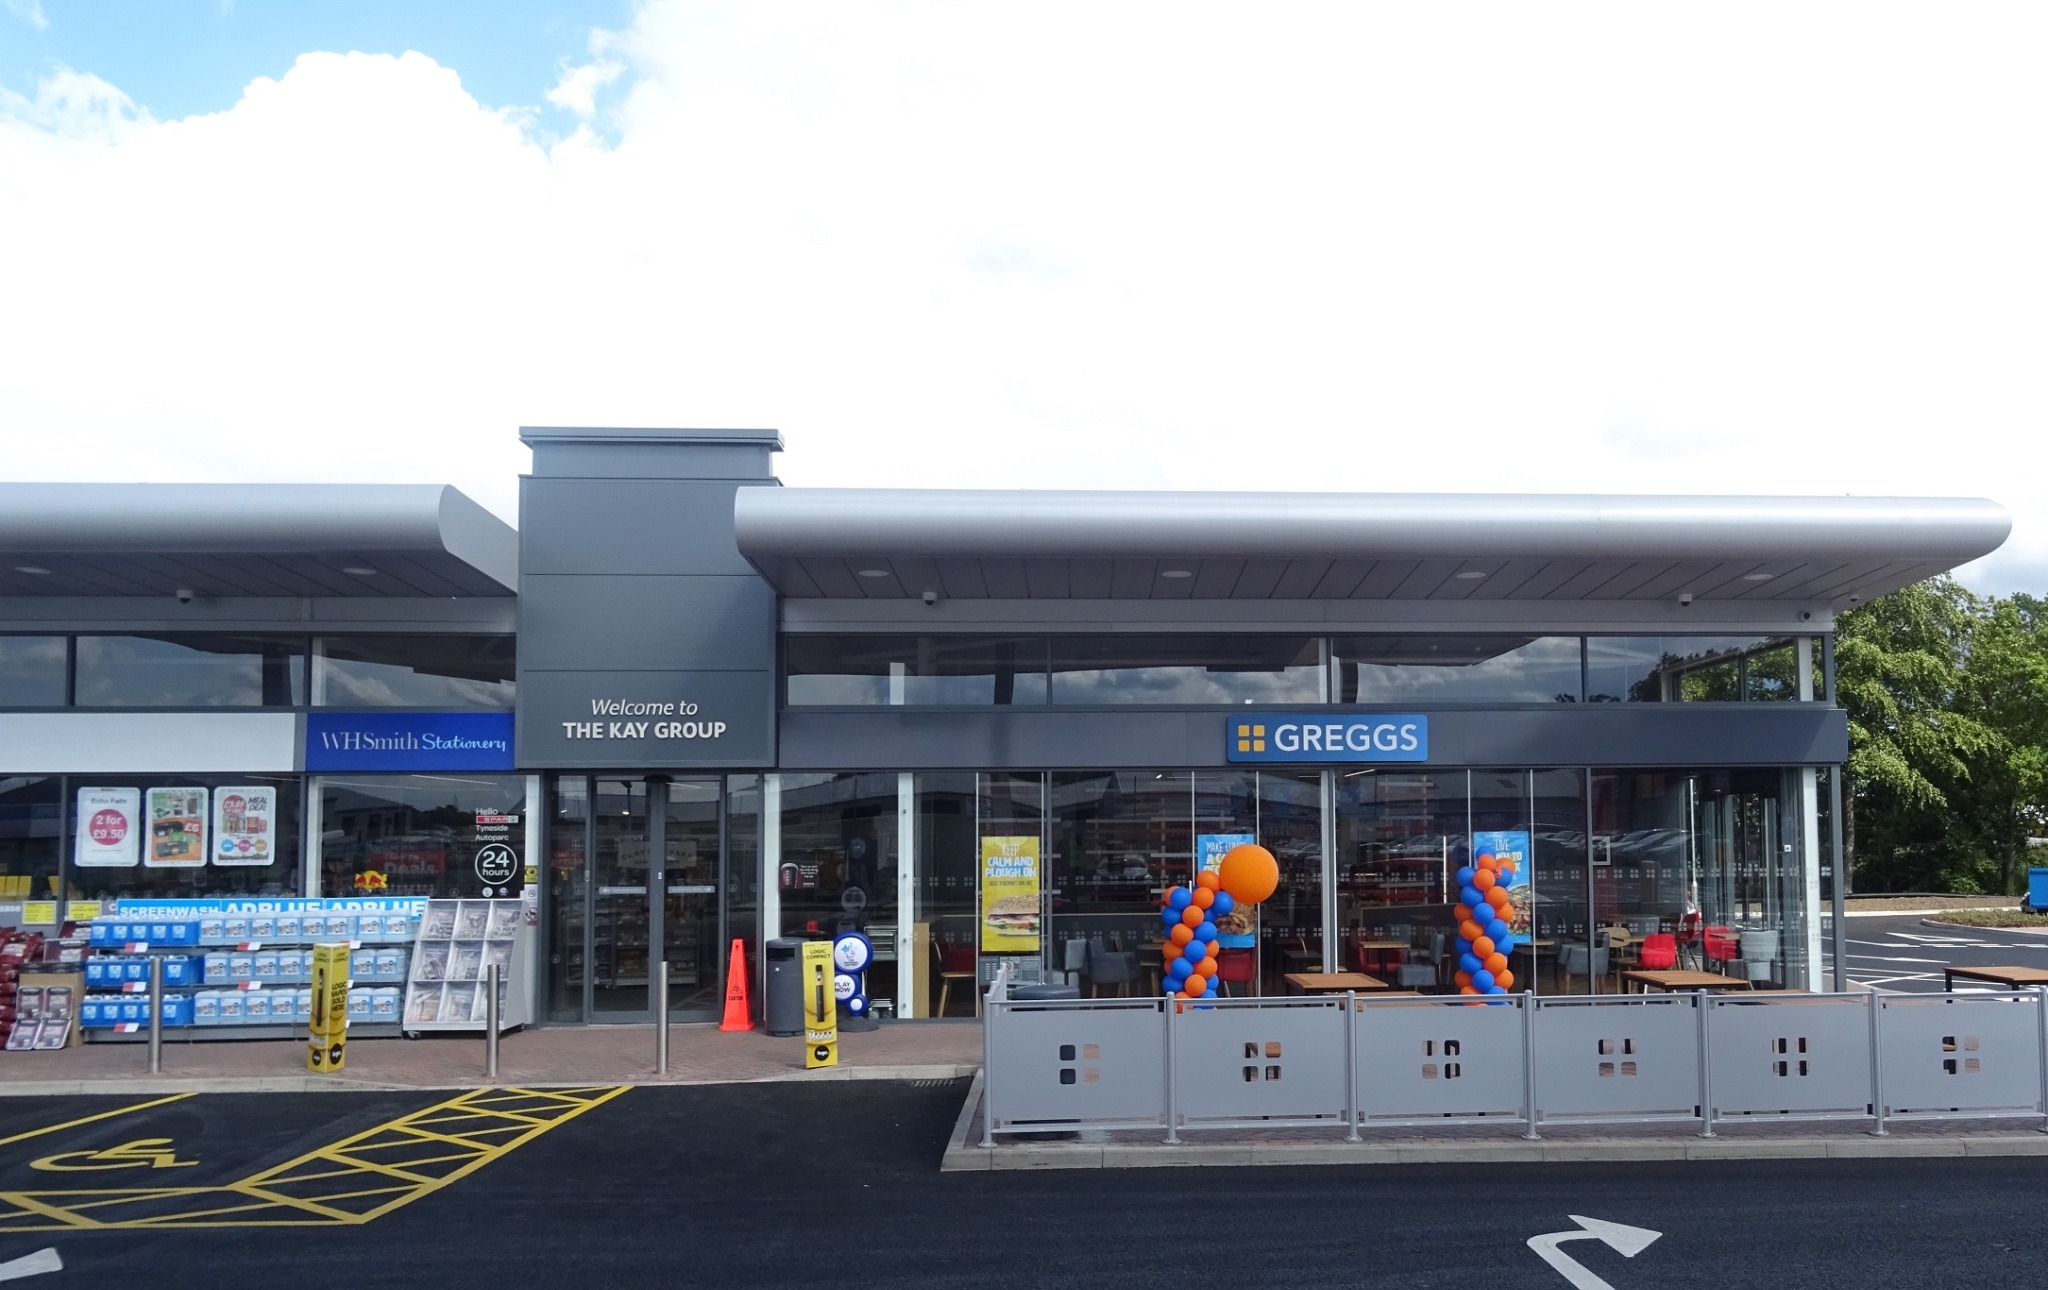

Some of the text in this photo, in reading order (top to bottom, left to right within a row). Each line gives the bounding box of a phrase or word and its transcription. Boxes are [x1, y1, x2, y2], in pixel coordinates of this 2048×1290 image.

[592, 699, 698, 716] Welcome to
[563, 722, 727, 739] THE KAY GROUP
[321, 731, 506, 752] WHSmith Stationery
[1274, 724, 1418, 751] GREGGS
[96, 815, 123, 825] 2 for
[184, 823, 200, 832] £6
[93, 829, 125, 839] £9.50
[475, 834, 509, 842] Autoparc
[1206, 841, 1224, 853] MAKE
[1495, 839, 1510, 851] LIVE
[482, 850, 510, 867] 24
[987, 856, 1034, 867] CALM AND
[985, 867, 1036, 877] PLOUGH ON
[119, 906, 219, 916] SCREENWASH
[332, 981, 348, 990] LOGIC
[331, 989, 348, 997] VAPES
[332, 996, 346, 1005] SOLD
[331, 1003, 346, 1012] HERE
